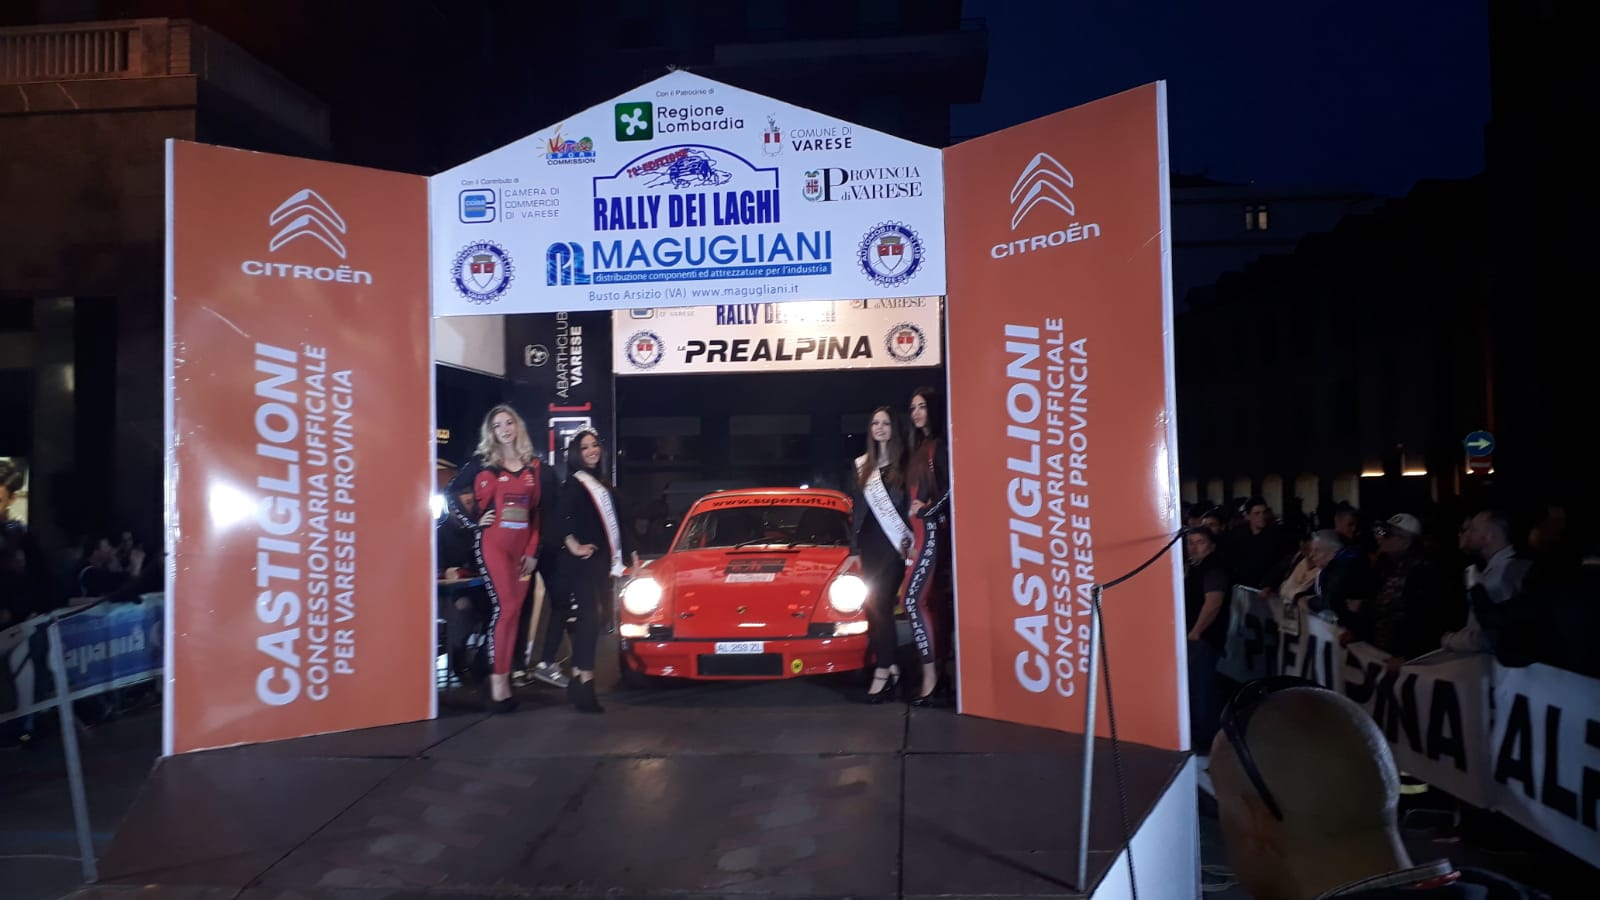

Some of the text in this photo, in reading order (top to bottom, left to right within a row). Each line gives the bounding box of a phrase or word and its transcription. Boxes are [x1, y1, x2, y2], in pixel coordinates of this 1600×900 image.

[657, 104, 725, 121] Regione
[658, 117, 745, 133] Lombardia
[790, 126, 852, 139] COMUNE DI
[792, 137, 853, 152] VARESE
[547, 158, 596, 166] COMMISSION
[504, 187, 560, 197] CAMERA DI
[816, 166, 921, 202] PROVINCIA
[841, 181, 923, 201] di VARESE
[504, 198, 560, 209] COMMERCIO
[505, 209, 560, 220] DI VARESE
[593, 189, 780, 231] RALLY DEI LAGHI
[592, 230, 832, 270] MAGUGLIANI
[595, 264, 828, 282] distribuzione componenti ed attrezzature per l'industria
[589, 283, 799, 301] Busto Arsizio (VA) www.magugliani.it
[880, 298, 927, 309] VARESE
[716, 303, 760, 326] RALLY
[556, 311, 569, 398] ABARTHCLUB
[569, 325, 583, 387] VARESE
[685, 335, 873, 364] PREALPINA
[1069, 337, 1089, 487] PROVINCIA
[1004, 322, 1051, 694] CASTIGLIONI
[1044, 317, 1075, 697] CONCESSIONARIA UFFICIALE
[1069, 492, 1090, 509] E
[255, 341, 301, 707] CASTIGLIONI
[304, 344, 330, 701] CONCESSIONARIA UFFICIALE
[332, 369, 356, 675] PER VARESE E PROVINCIA
[924, 522, 937, 557] MISS
[908, 558, 931, 596] RALLY
[1071, 515, 1096, 617] VARESE
